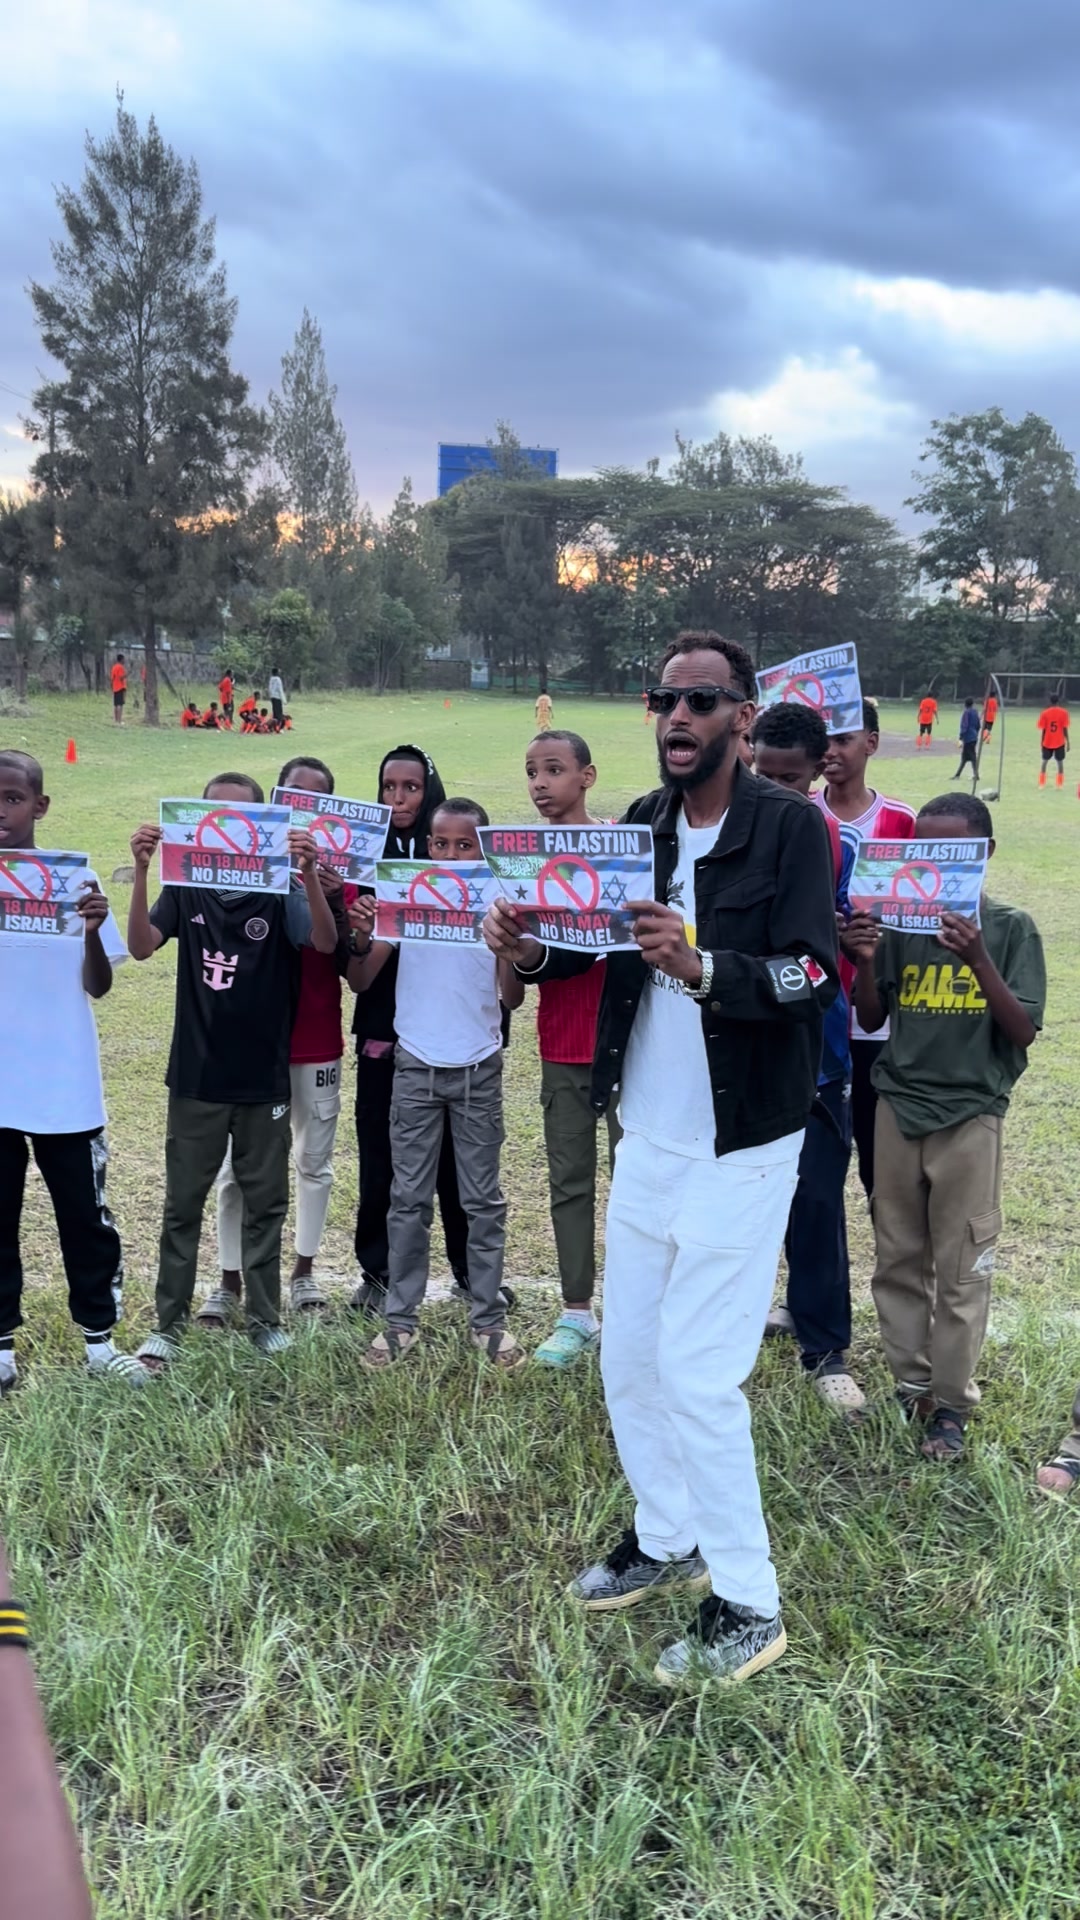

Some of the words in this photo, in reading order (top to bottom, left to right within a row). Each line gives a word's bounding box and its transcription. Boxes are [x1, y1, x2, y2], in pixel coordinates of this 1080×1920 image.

[788, 649, 848, 676] FALASTIIN
[1050, 721, 1058, 733] 5
[282, 793, 315, 810] FREE
[318, 798, 382, 822] FALASTIIN
[492, 832, 538, 853] FREE
[543, 832, 640, 854] FALASTIIN
[866, 844, 902, 859] FREE
[904, 844, 978, 860] FALASTIIN
[191, 852, 212, 866] NO
[216, 854, 231, 868] 18
[234, 856, 265, 871] MAY
[191, 866, 213, 882] NO
[217, 868, 267, 887] ISRAEL
[3, 899, 21, 914] 18
[24, 900, 58, 917] MAY
[882, 903, 899, 915] NO
[903, 904, 915, 915] 18
[917, 904, 945, 916] MAY
[4, 915, 60, 933] ISRAEL
[403, 909, 424, 923] NO
[428, 911, 442, 924] 18
[446, 912, 475, 927] MAY
[536, 912, 556, 924] NO
[560, 914, 574, 927] 18
[577, 914, 612, 930] MAY
[881, 914, 899, 926] NO
[404, 922, 425, 938] NO
[428, 924, 477, 942] ISRAEL
[540, 922, 559, 938] NO
[563, 926, 616, 946] ISRAEL
[899, 964, 987, 1009] GAME
[315, 1067, 337, 1087] BIG
